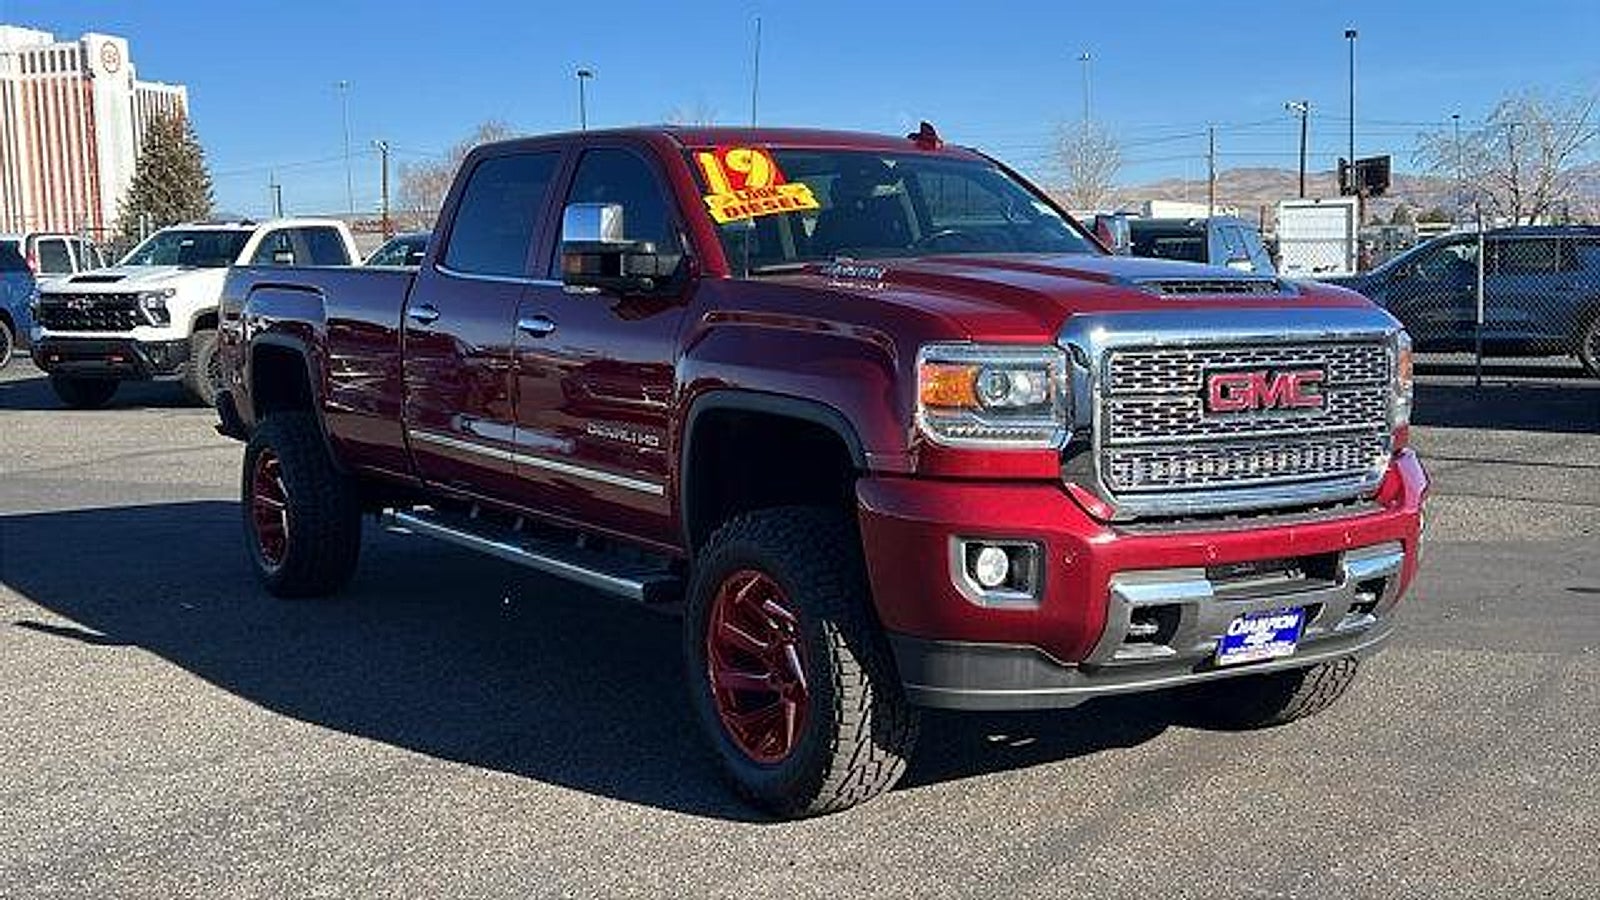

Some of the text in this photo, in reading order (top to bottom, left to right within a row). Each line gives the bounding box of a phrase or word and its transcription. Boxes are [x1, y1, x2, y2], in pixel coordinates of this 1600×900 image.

[698, 148, 771, 194] 19
[722, 197, 808, 218] DIESEL
[1207, 369, 1324, 412] GMC
[637, 433, 659, 447] HD
